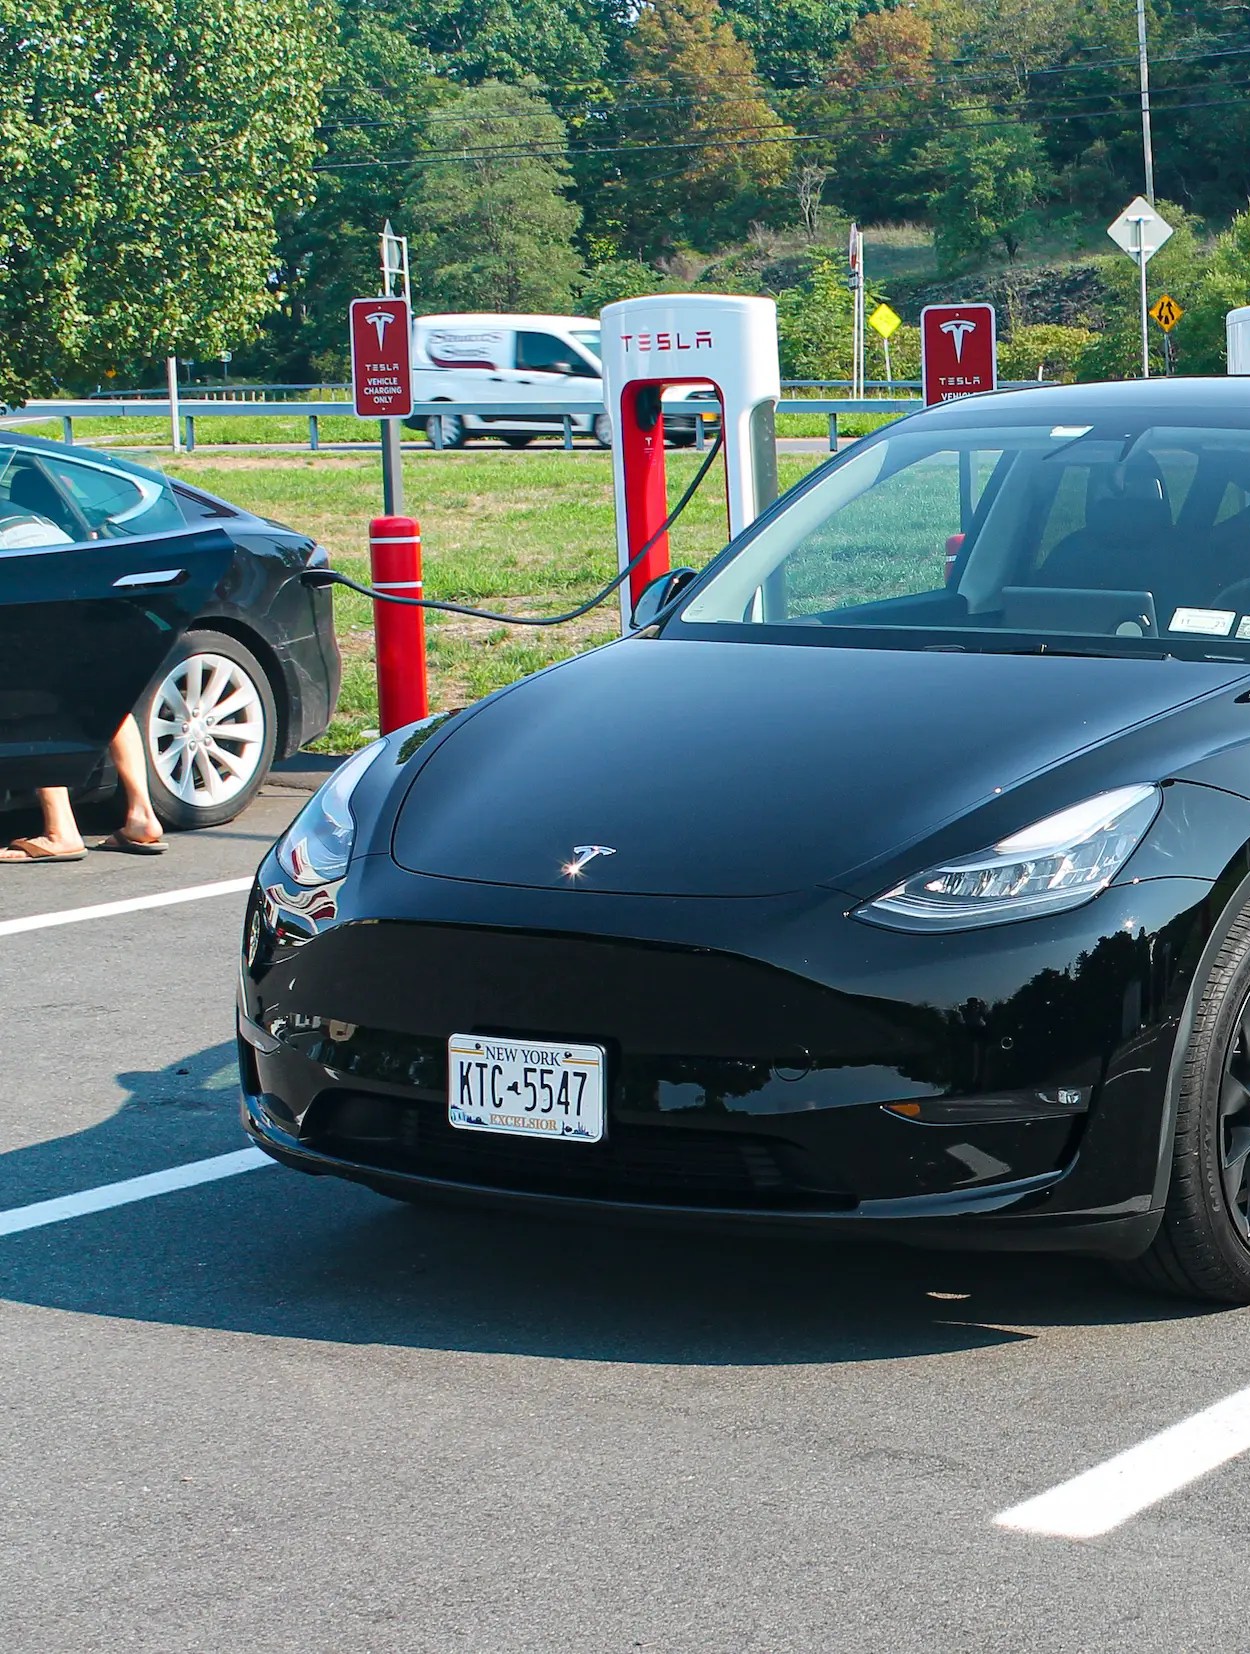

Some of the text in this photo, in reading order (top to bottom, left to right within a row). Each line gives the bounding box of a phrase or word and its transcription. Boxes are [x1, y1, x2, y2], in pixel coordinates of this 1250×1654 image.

[620, 331, 712, 352] TESLA
[365, 363, 399, 371] TESLA
[367, 377, 398, 386] VEHICLE
[939, 376, 980, 386] TESLA
[363, 386, 402, 395] CHARGING
[373, 396, 393, 404] ONLY
[485, 1046, 561, 1067] NEW YORK
[459, 1061, 588, 1116] KTC 5547
[489, 1113, 558, 1131] EXCELSIOR
